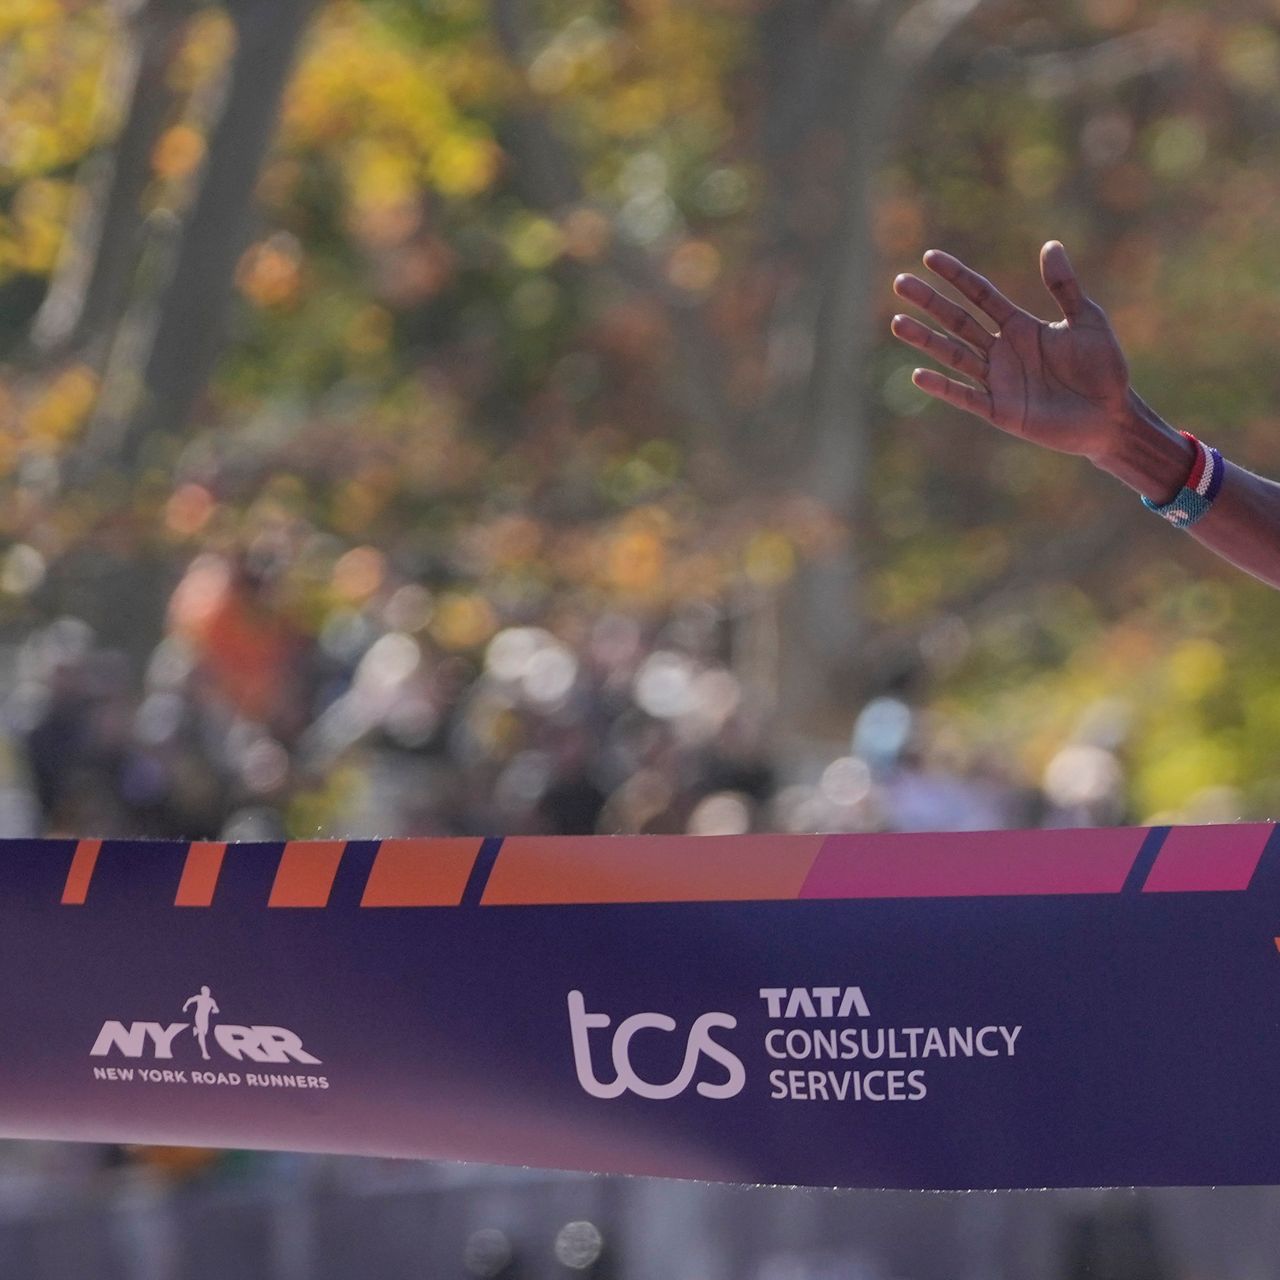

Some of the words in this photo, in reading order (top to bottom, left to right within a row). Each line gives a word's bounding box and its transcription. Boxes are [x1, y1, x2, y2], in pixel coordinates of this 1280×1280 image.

[760, 986, 870, 1017] TATA
[567, 989, 746, 1100] tcs
[765, 1026, 1022, 1059] CONSULTANCY
[94, 1067, 134, 1081] NEW
[138, 1069, 188, 1084] YORK
[192, 1071, 241, 1086] ROAD
[246, 1073, 329, 1089] RUNNERS
[769, 1069, 928, 1101] SERVICES
